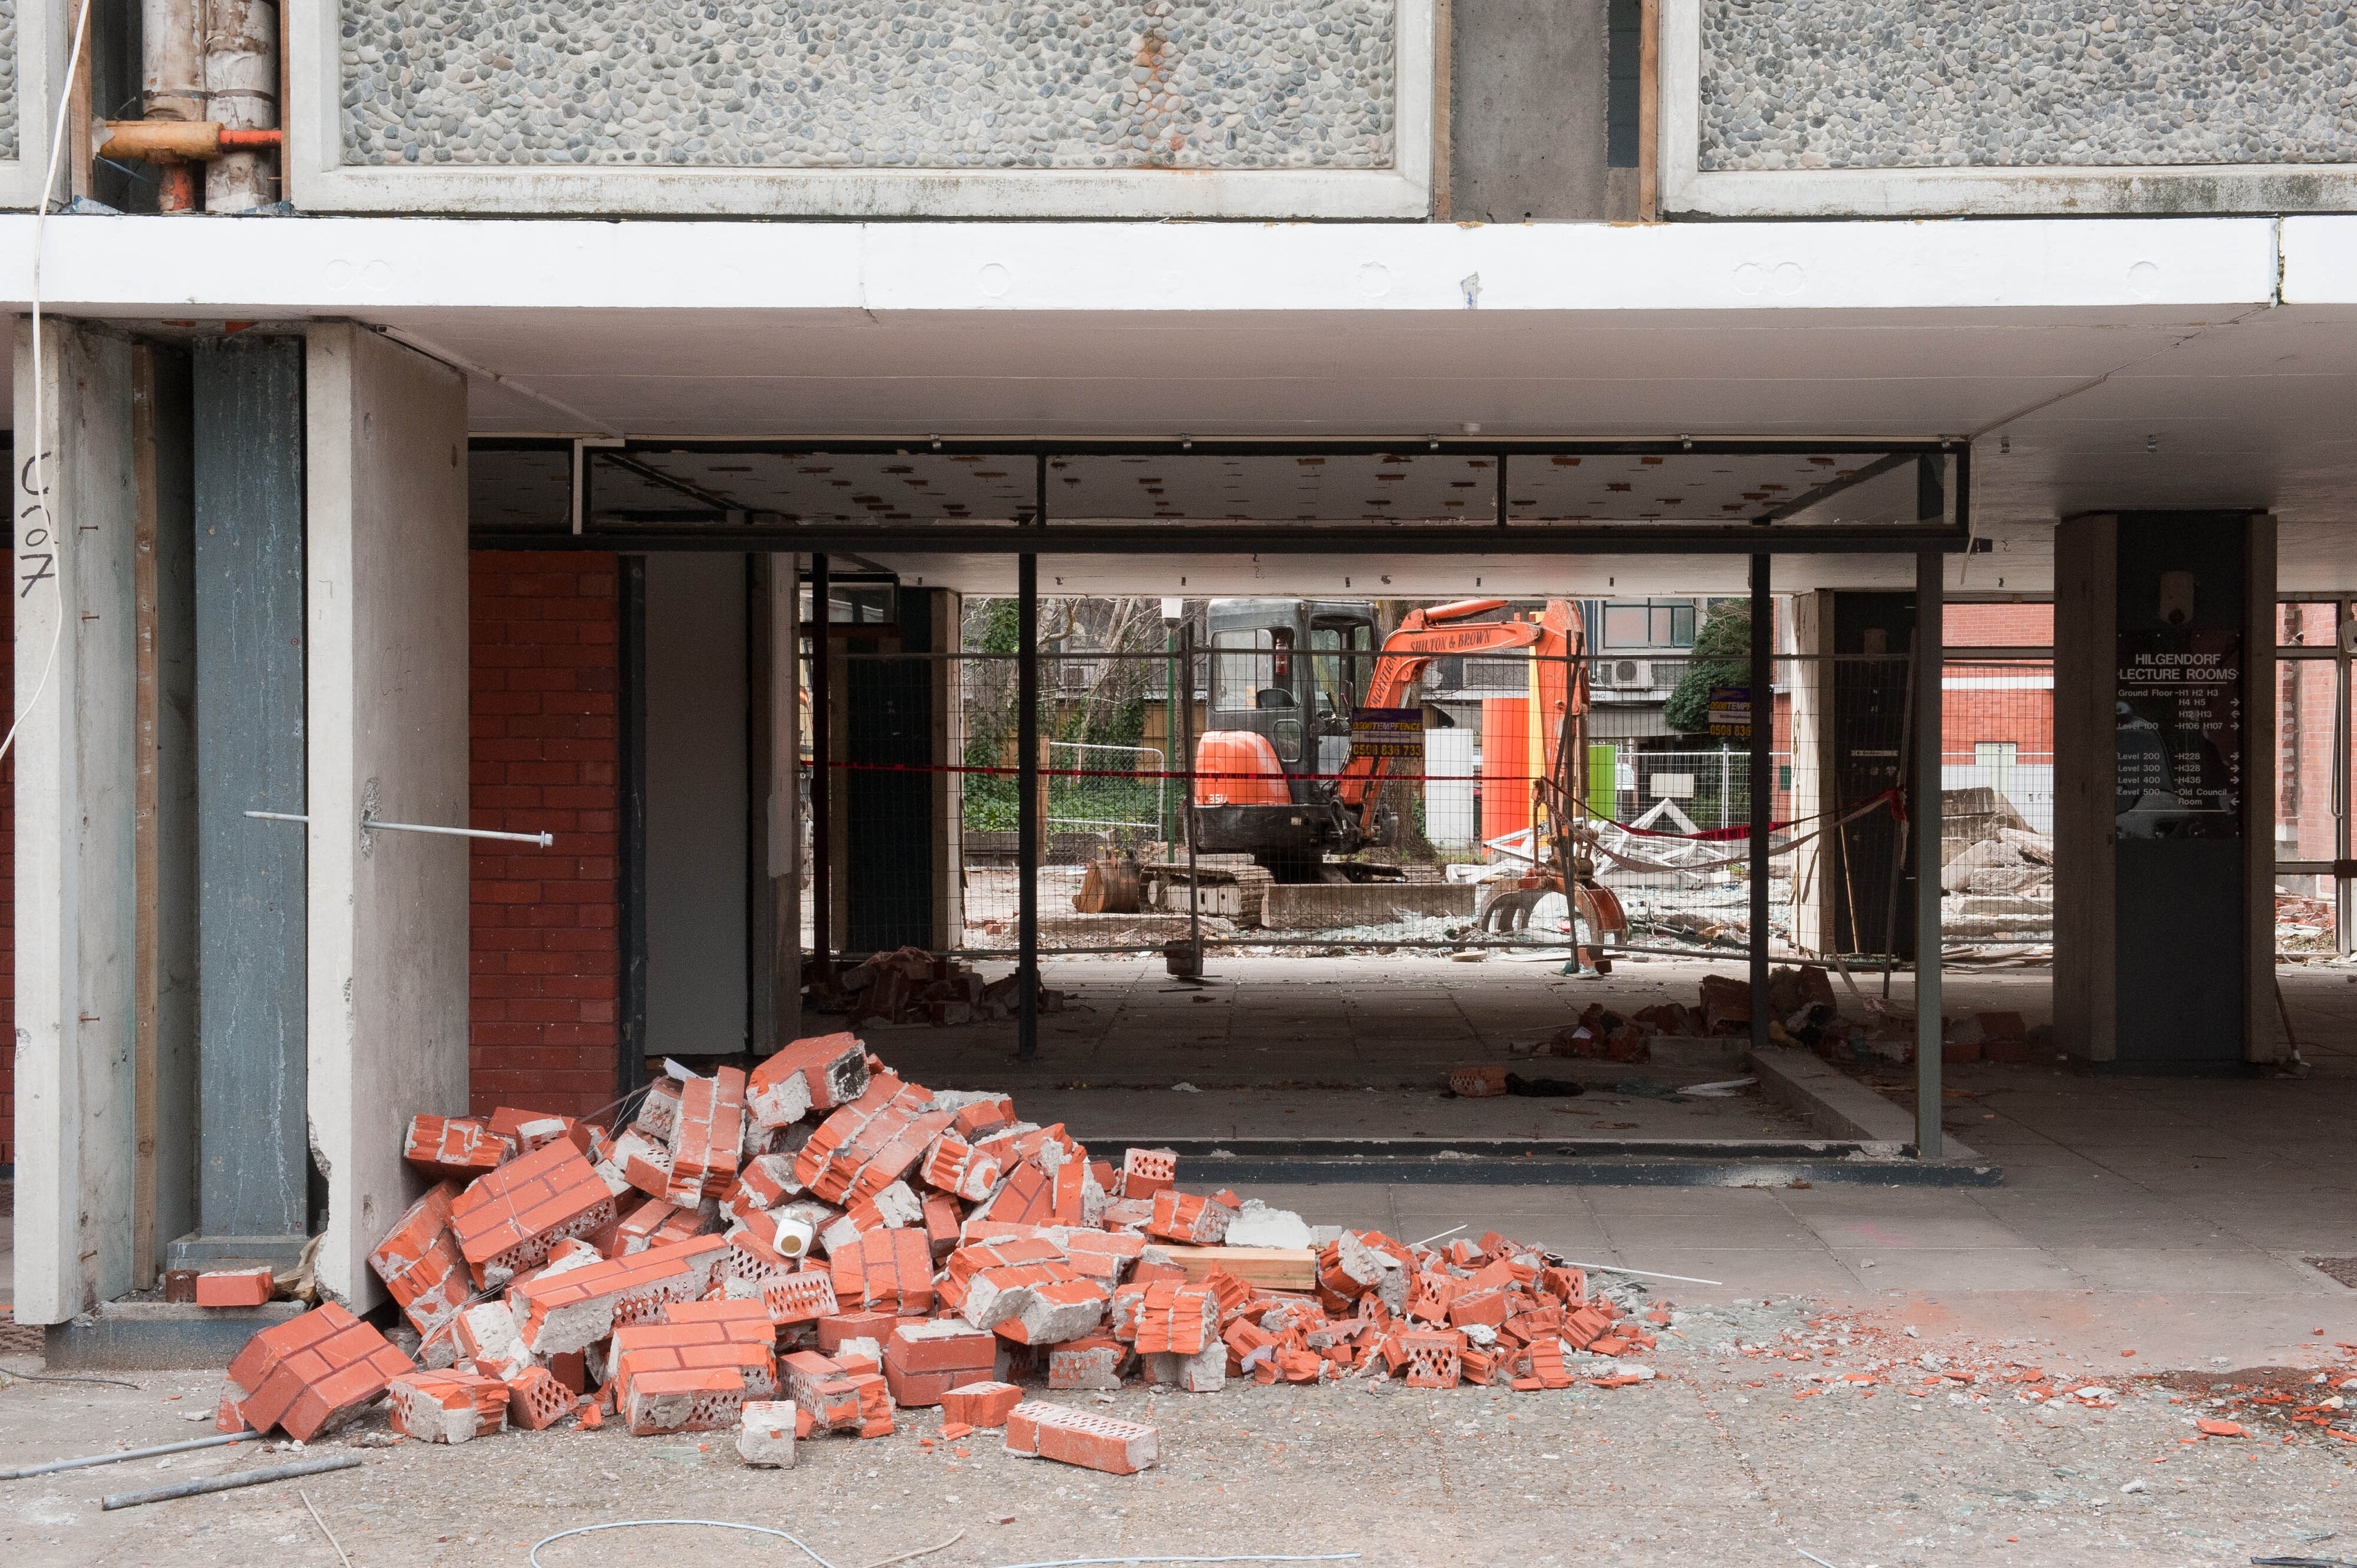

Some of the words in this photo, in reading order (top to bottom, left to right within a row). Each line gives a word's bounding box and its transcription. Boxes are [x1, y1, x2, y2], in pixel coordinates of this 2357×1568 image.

[1410, 636, 1447, 652] SHILTON
[1449, 635, 1456, 649] &
[1458, 630, 1491, 648] BROWN
[2135, 653, 2221, 665] HILGENDORF
[2119, 669, 2180, 679] LECTURE
[2187, 669, 2237, 679] ROOMS
[1710, 725, 1732, 735] 0508
[1353, 744, 1378, 755] 0508
[1382, 744, 1400, 755] 836
[1403, 745, 1422, 755] 733
